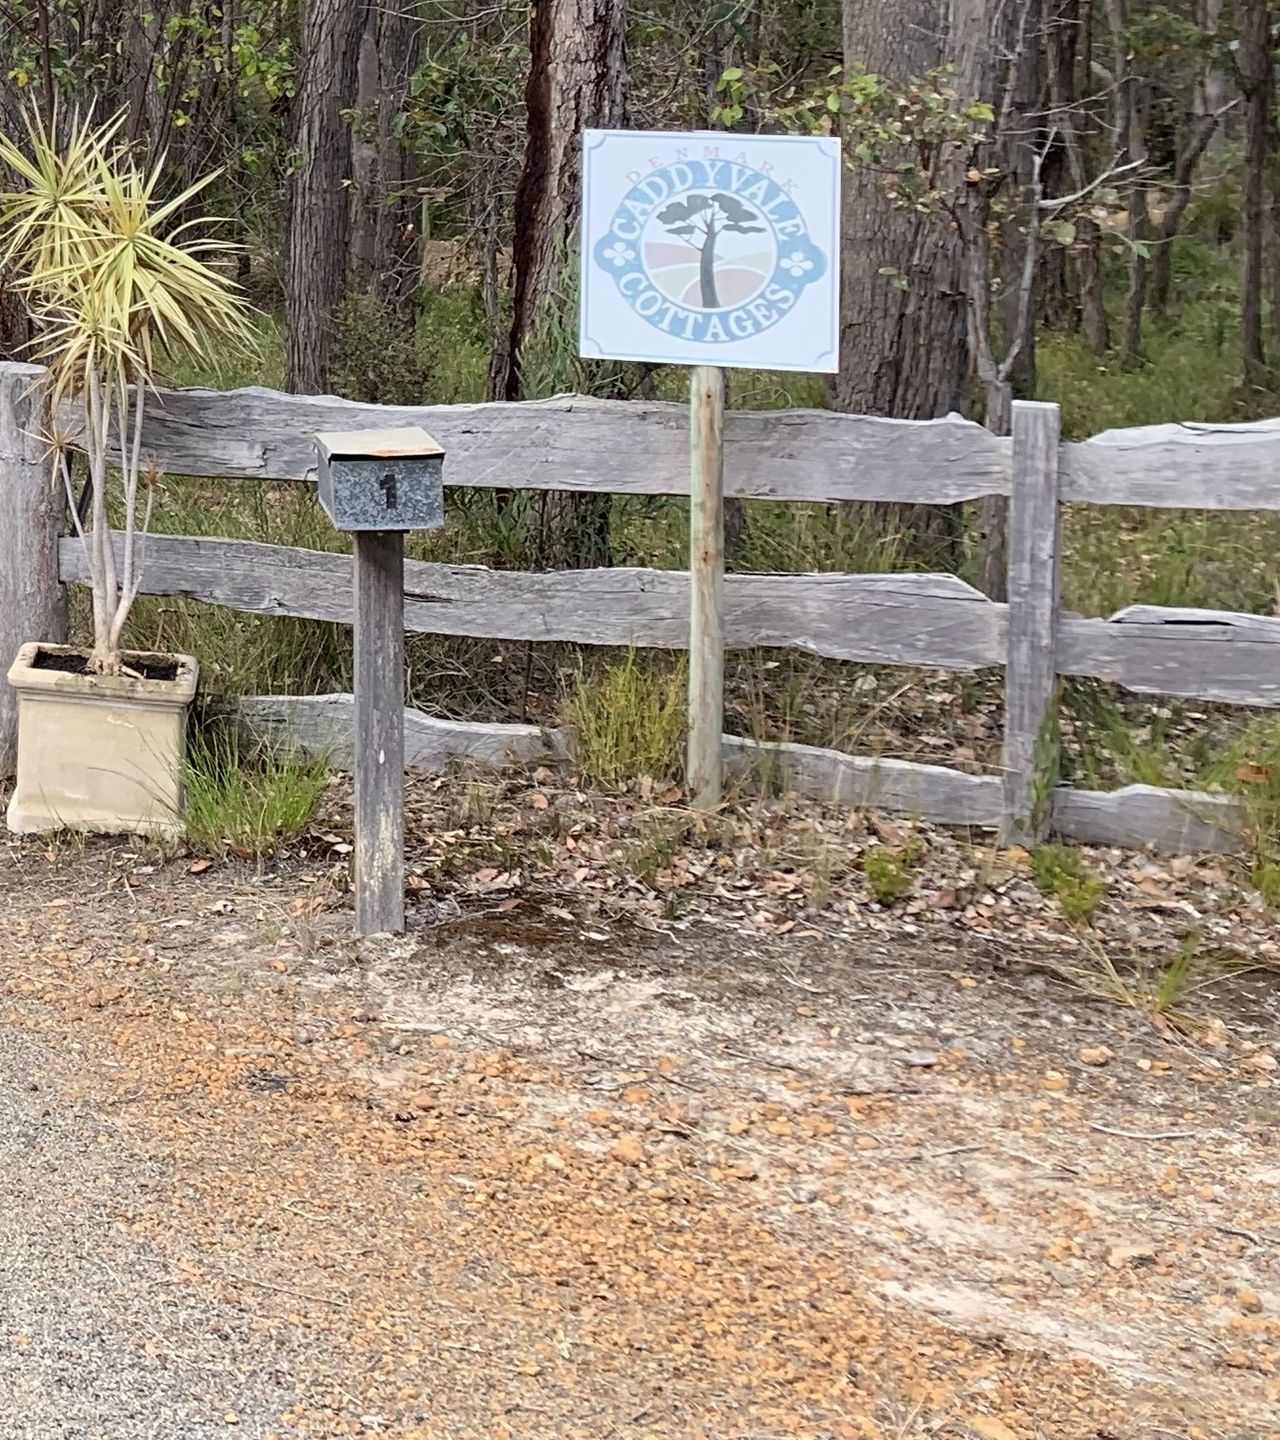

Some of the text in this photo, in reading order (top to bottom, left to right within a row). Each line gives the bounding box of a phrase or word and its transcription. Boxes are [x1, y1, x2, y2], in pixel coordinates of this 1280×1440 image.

[625, 144, 801, 196] DENMARK
[612, 160, 805, 242] CADDYVALE
[619, 272, 795, 342] COTTAGES
[379, 473, 397, 510] 1
